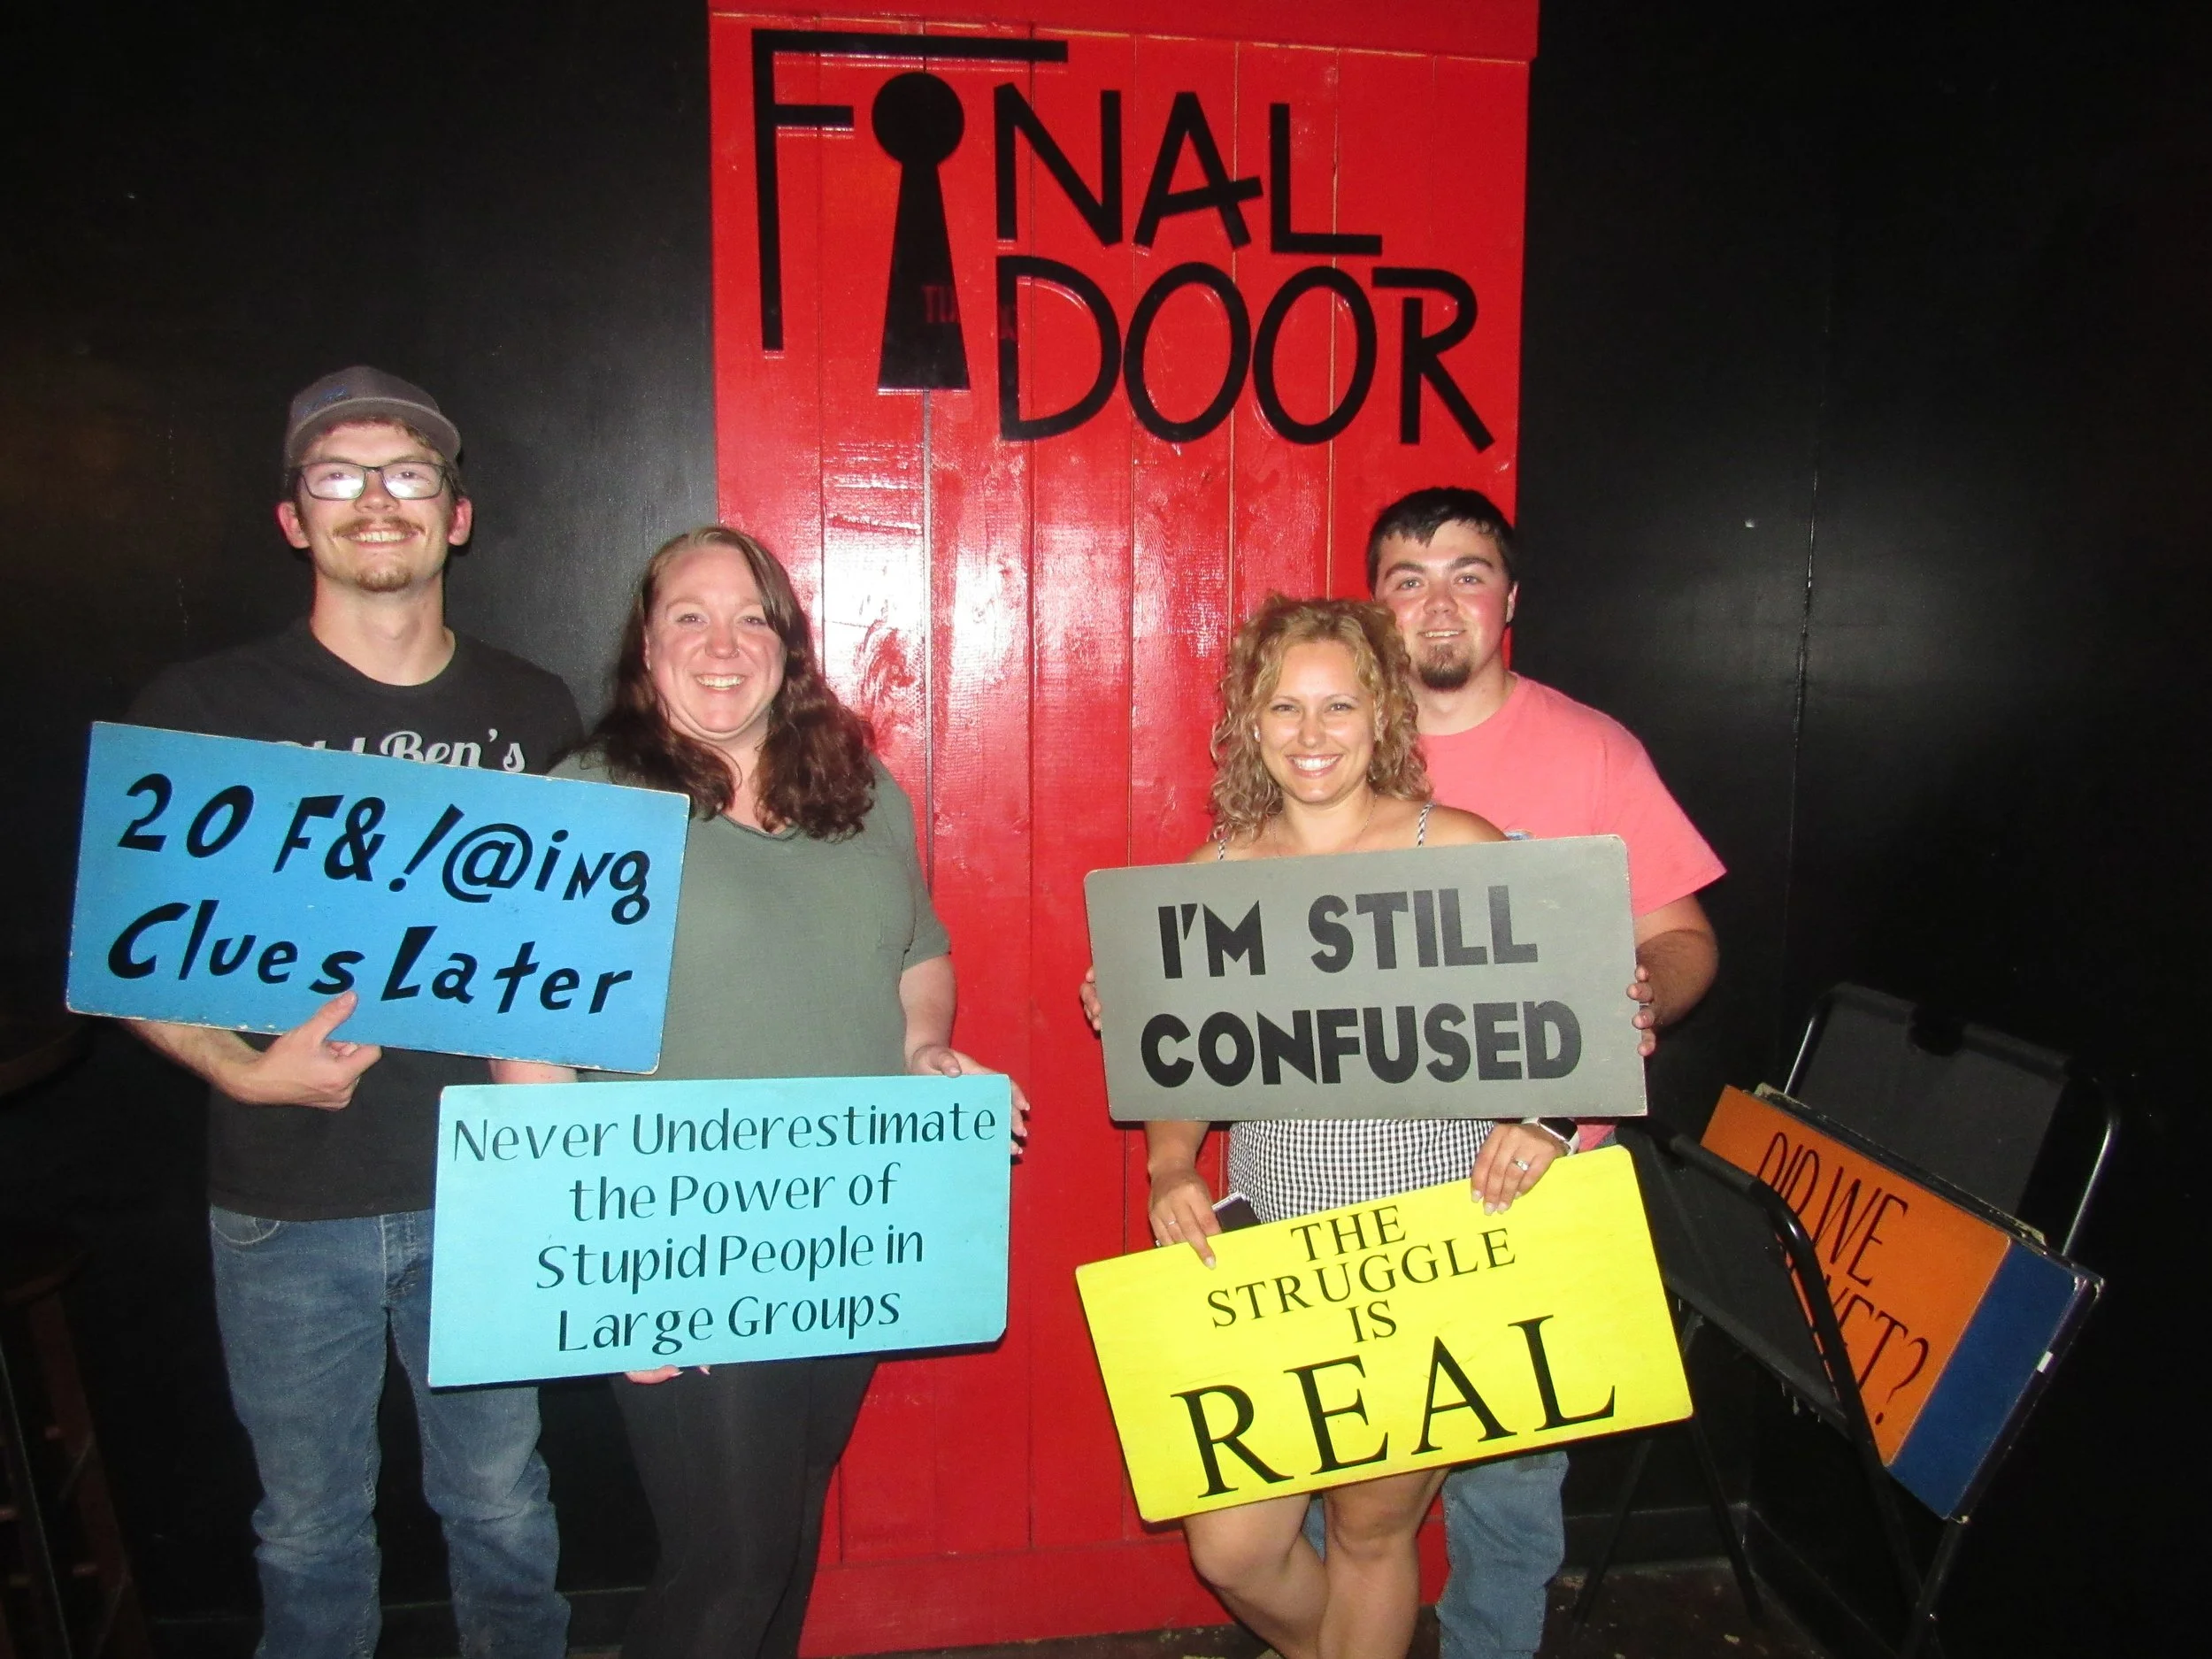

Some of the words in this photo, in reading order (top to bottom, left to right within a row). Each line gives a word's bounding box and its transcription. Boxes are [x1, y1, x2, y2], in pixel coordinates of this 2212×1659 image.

[751, 27, 1383, 391] FINAL
[995, 253, 1495, 454] DOOR
[380, 728, 526, 773] Ben's
[117, 772, 256, 860] 20
[107, 898, 366, 997] Clues
[380, 925, 634, 1016] Later
[1157, 899, 1267, 979] I'M
[1307, 885, 1539, 974] STILL
[1140, 999, 1583, 1089] CONFUSED
[453, 1118, 618, 1163] Never
[633, 1102, 997, 1156] Underestimate
[569, 1174, 657, 1222] the
[669, 1172, 835, 1217] Power
[849, 1161, 901, 1207] of
[1290, 1204, 1407, 1263] THE
[1812, 1165, 1909, 1288] WE
[535, 1233, 708, 1295] Stupid
[718, 1225, 874, 1282] People
[886, 1223, 925, 1266] in
[1206, 1227, 1516, 1329] STRUGGLE
[557, 1308, 714, 1356] Large
[727, 1290, 902, 1340] Groups
[1346, 1299, 1398, 1344] IS
[1170, 1314, 1617, 1500] REAL
